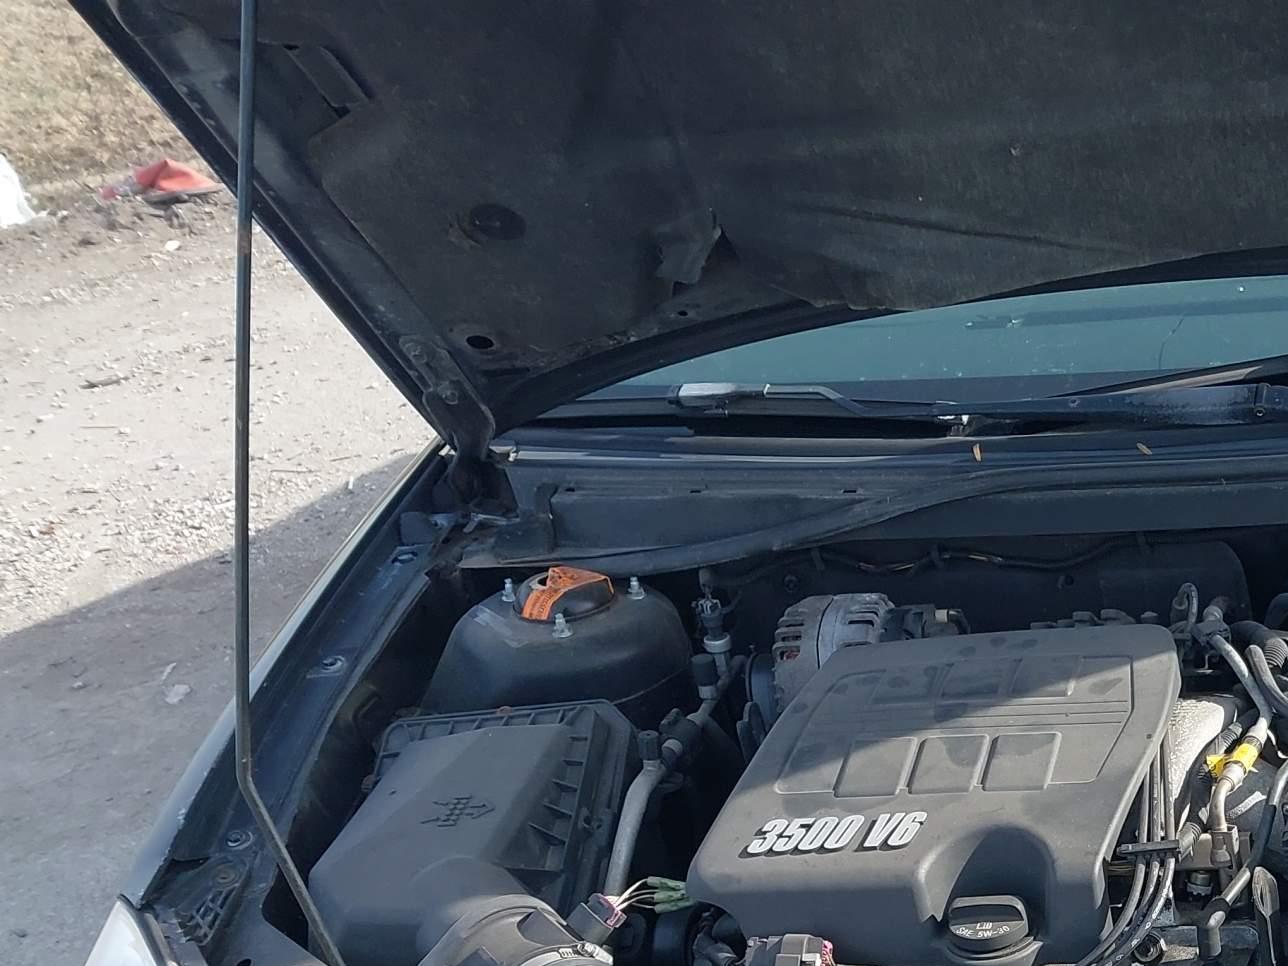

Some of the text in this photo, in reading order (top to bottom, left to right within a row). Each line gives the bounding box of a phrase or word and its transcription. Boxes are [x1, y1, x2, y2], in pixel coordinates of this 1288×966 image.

[745, 811, 929, 856] 3500 V6
[956, 926, 976, 937] SAE
[976, 925, 1010, 938] 5W-30
